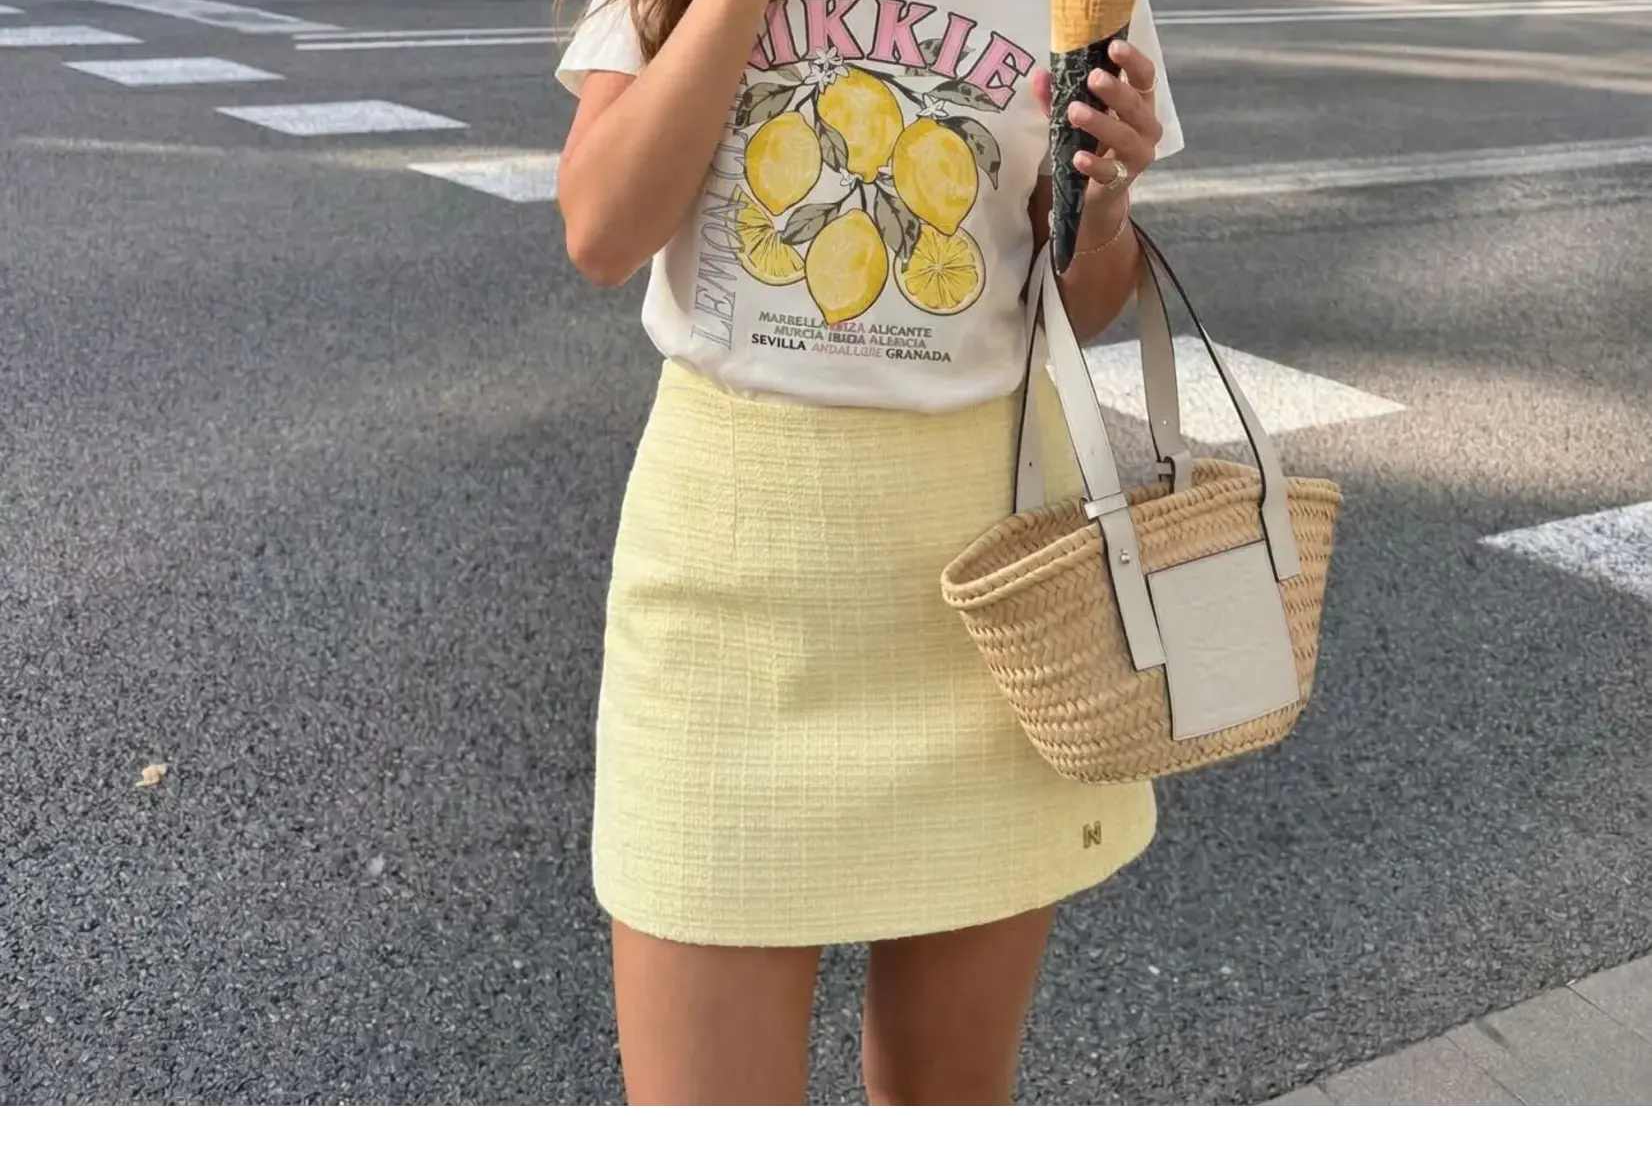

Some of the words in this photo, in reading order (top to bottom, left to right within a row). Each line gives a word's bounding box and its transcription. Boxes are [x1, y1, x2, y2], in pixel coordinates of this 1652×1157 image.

[691, 185, 749, 351] LEMON
[774, 325, 824, 341] MURCIA
[868, 324, 933, 338] ALICANTE
[751, 333, 807, 351] SEVILLA
[885, 348, 952, 362] GRANADA
